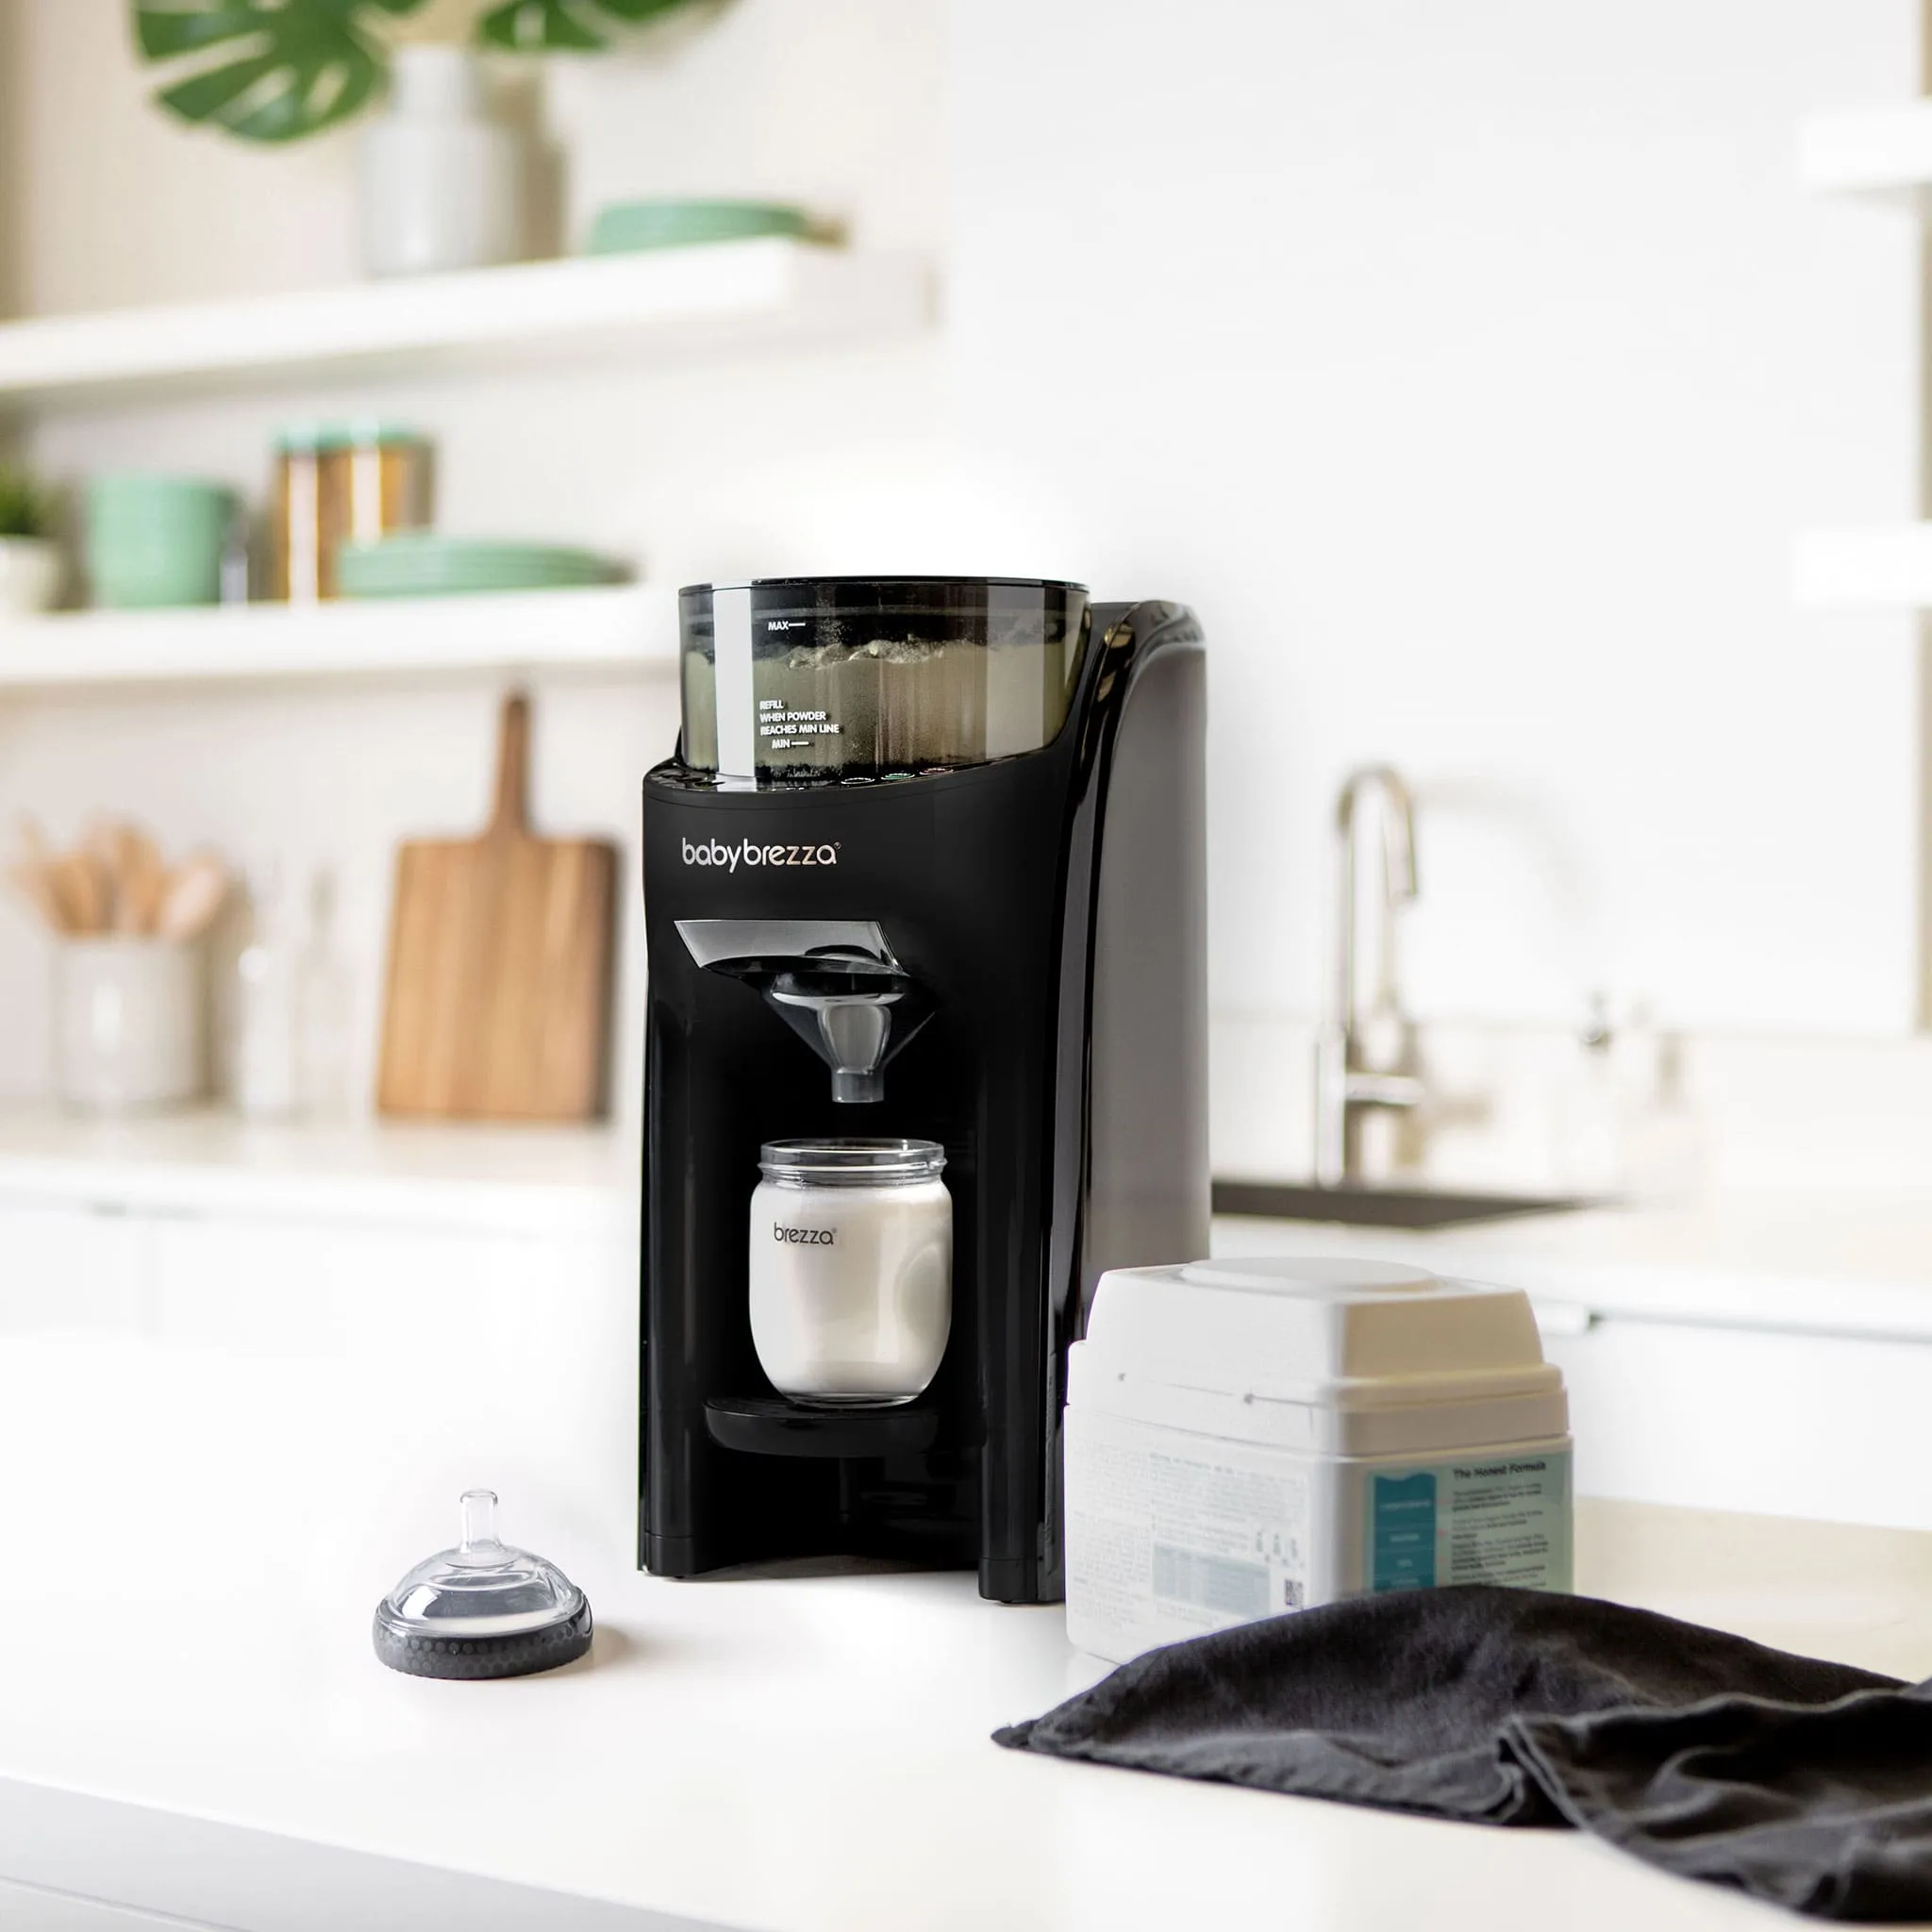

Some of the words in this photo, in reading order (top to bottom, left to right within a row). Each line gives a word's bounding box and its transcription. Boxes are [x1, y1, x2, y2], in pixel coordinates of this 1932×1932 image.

[768, 621, 790, 631] MAX
[759, 700, 784, 709] REFILL
[759, 712, 786, 723] WHEN
[787, 711, 826, 721] POWDER
[760, 724, 797, 736] REACHES
[799, 724, 818, 733] MIN
[819, 724, 840, 733] LINE
[772, 739, 790, 749] MIN
[1454, 1467, 1472, 1479] The
[1508, 1460, 1546, 1474] Formula
